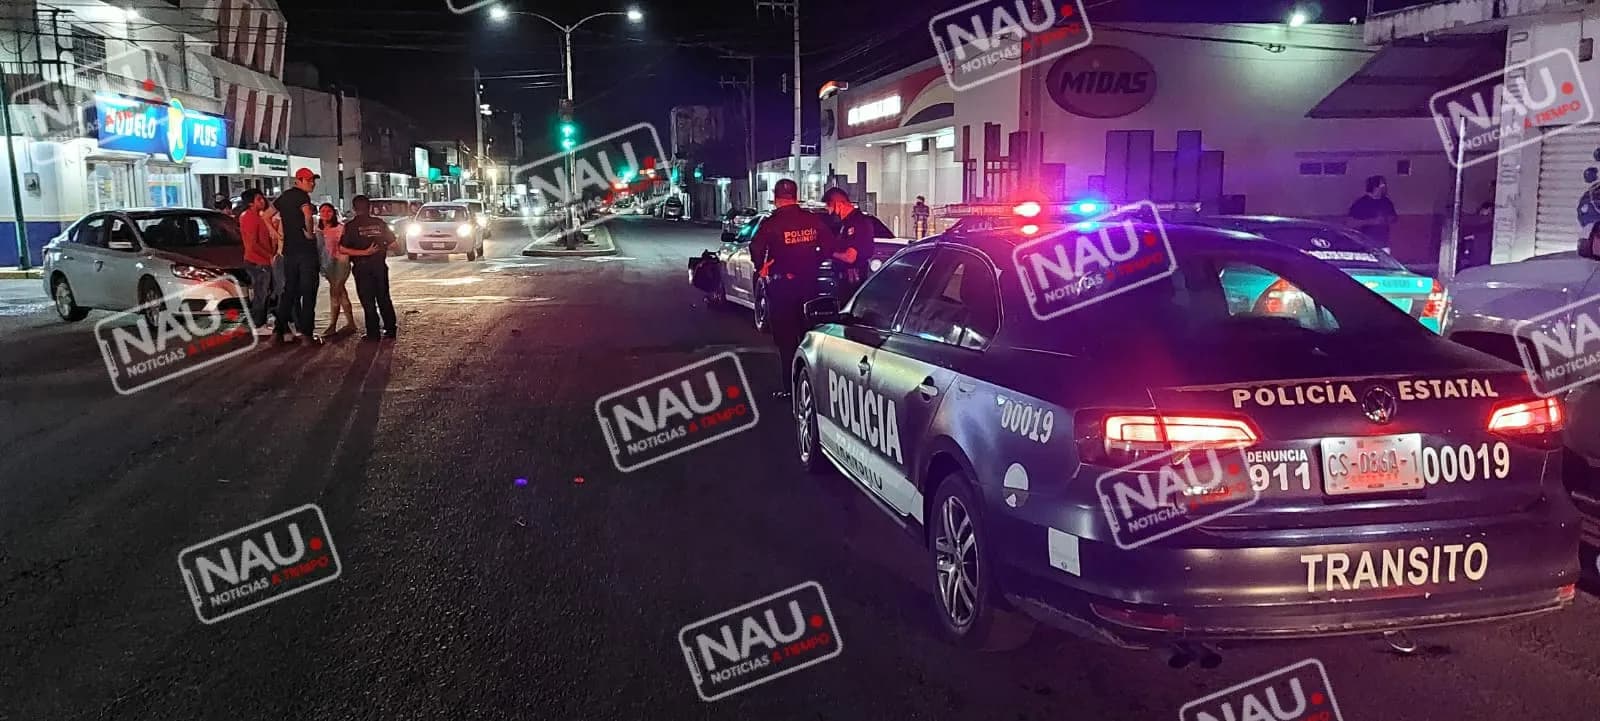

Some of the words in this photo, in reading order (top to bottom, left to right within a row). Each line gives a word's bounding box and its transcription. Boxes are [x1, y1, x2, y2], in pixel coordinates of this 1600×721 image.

[1061, 72, 1149, 94] MIDAS
[193, 122, 218, 148] PLUS
[1398, 378, 1499, 401] ESTATAL
[828, 368, 904, 465] POLICIA
[1001, 400, 1055, 444] 00019
[1248, 450, 1308, 463] DENUNCIA
[1424, 442, 1510, 484] 00019
[1250, 462, 1311, 492] 911
[1300, 542, 1488, 592] TRANSITO
